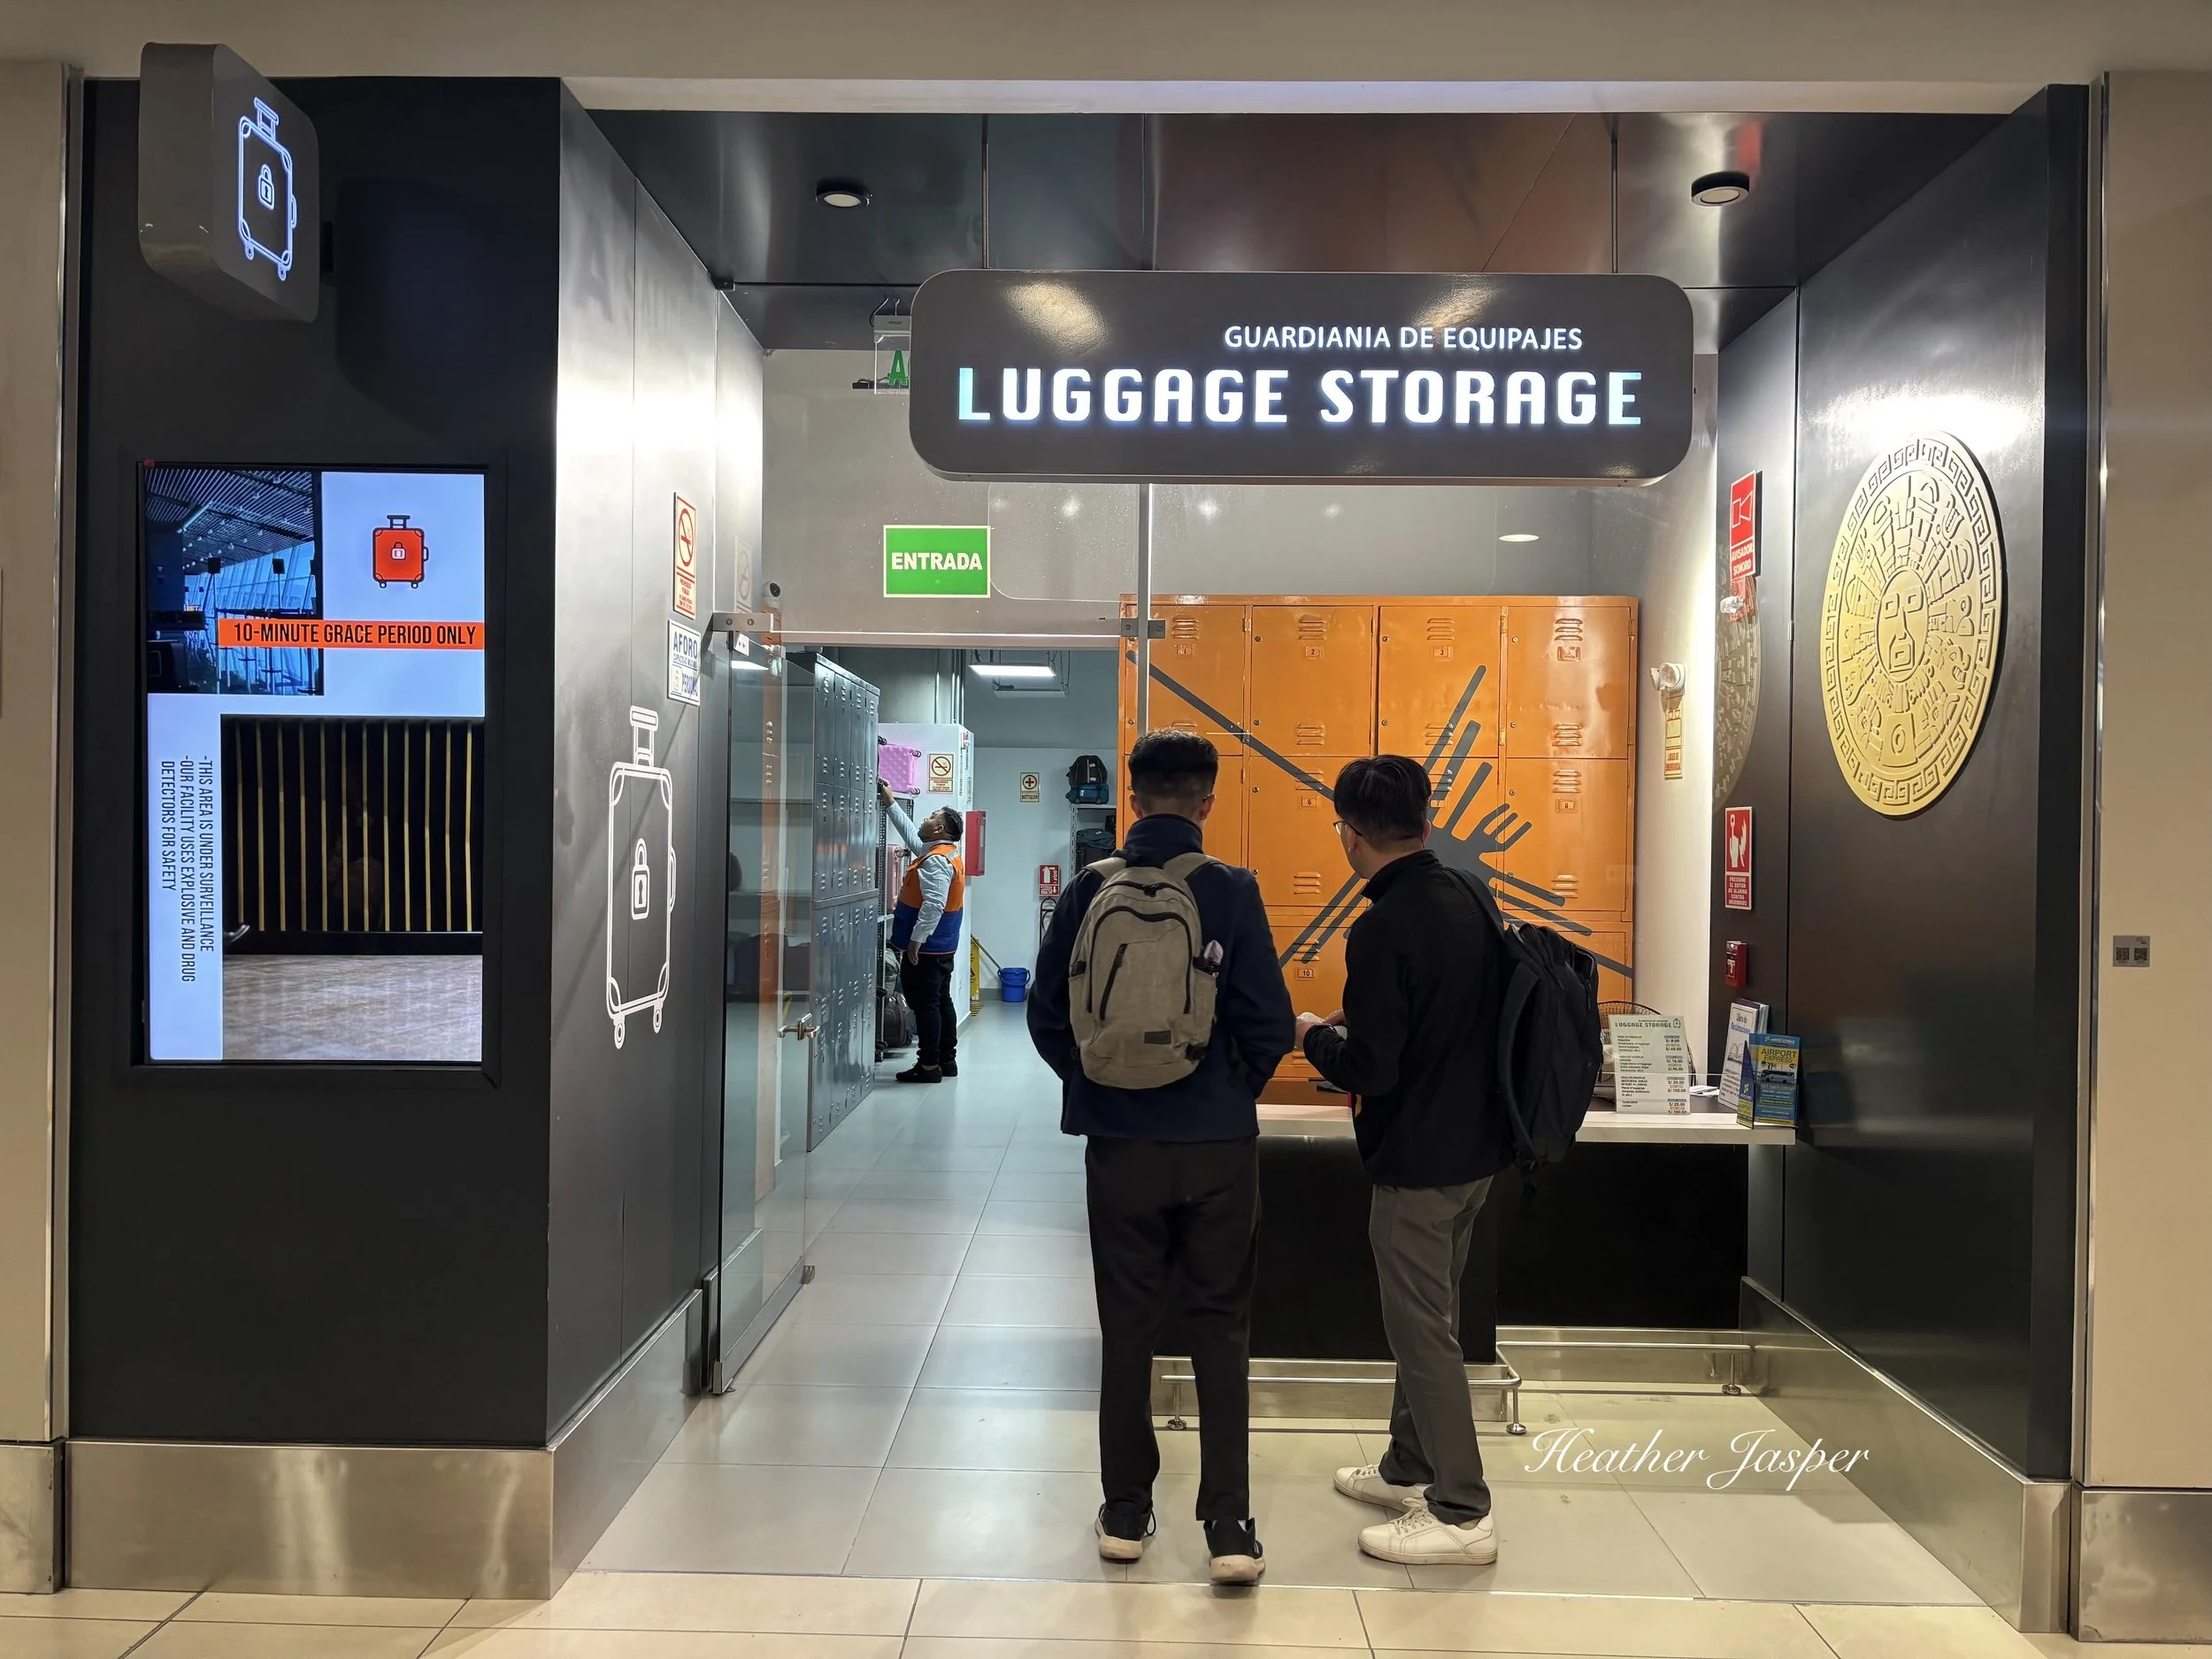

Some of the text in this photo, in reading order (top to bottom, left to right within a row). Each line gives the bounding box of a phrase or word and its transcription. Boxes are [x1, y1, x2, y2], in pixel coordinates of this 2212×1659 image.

[1225, 325, 1583, 351] GUARDIANIA DE EQUIPAJES
[958, 367, 1642, 425] LUGGAGE STORAGE
[891, 552, 983, 571] ENTRADA
[1733, 558, 1752, 576] SONORO
[234, 622, 476, 645] 10-MINUTE GRACE PERIOD ONLY
[673, 631, 698, 660] AFORO
[161, 761, 176, 891] DETECTORS FOR SAFETY
[199, 755, 214, 952] -THIS AREA IS UNDER SURVEILLANCE
[180, 755, 196, 982] -OUR FACILITY USES EXPLOSIVE AND DRUG
[1761, 1048, 1797, 1058] AIRPORT
[1764, 1054, 1793, 1063] EXPRESS
